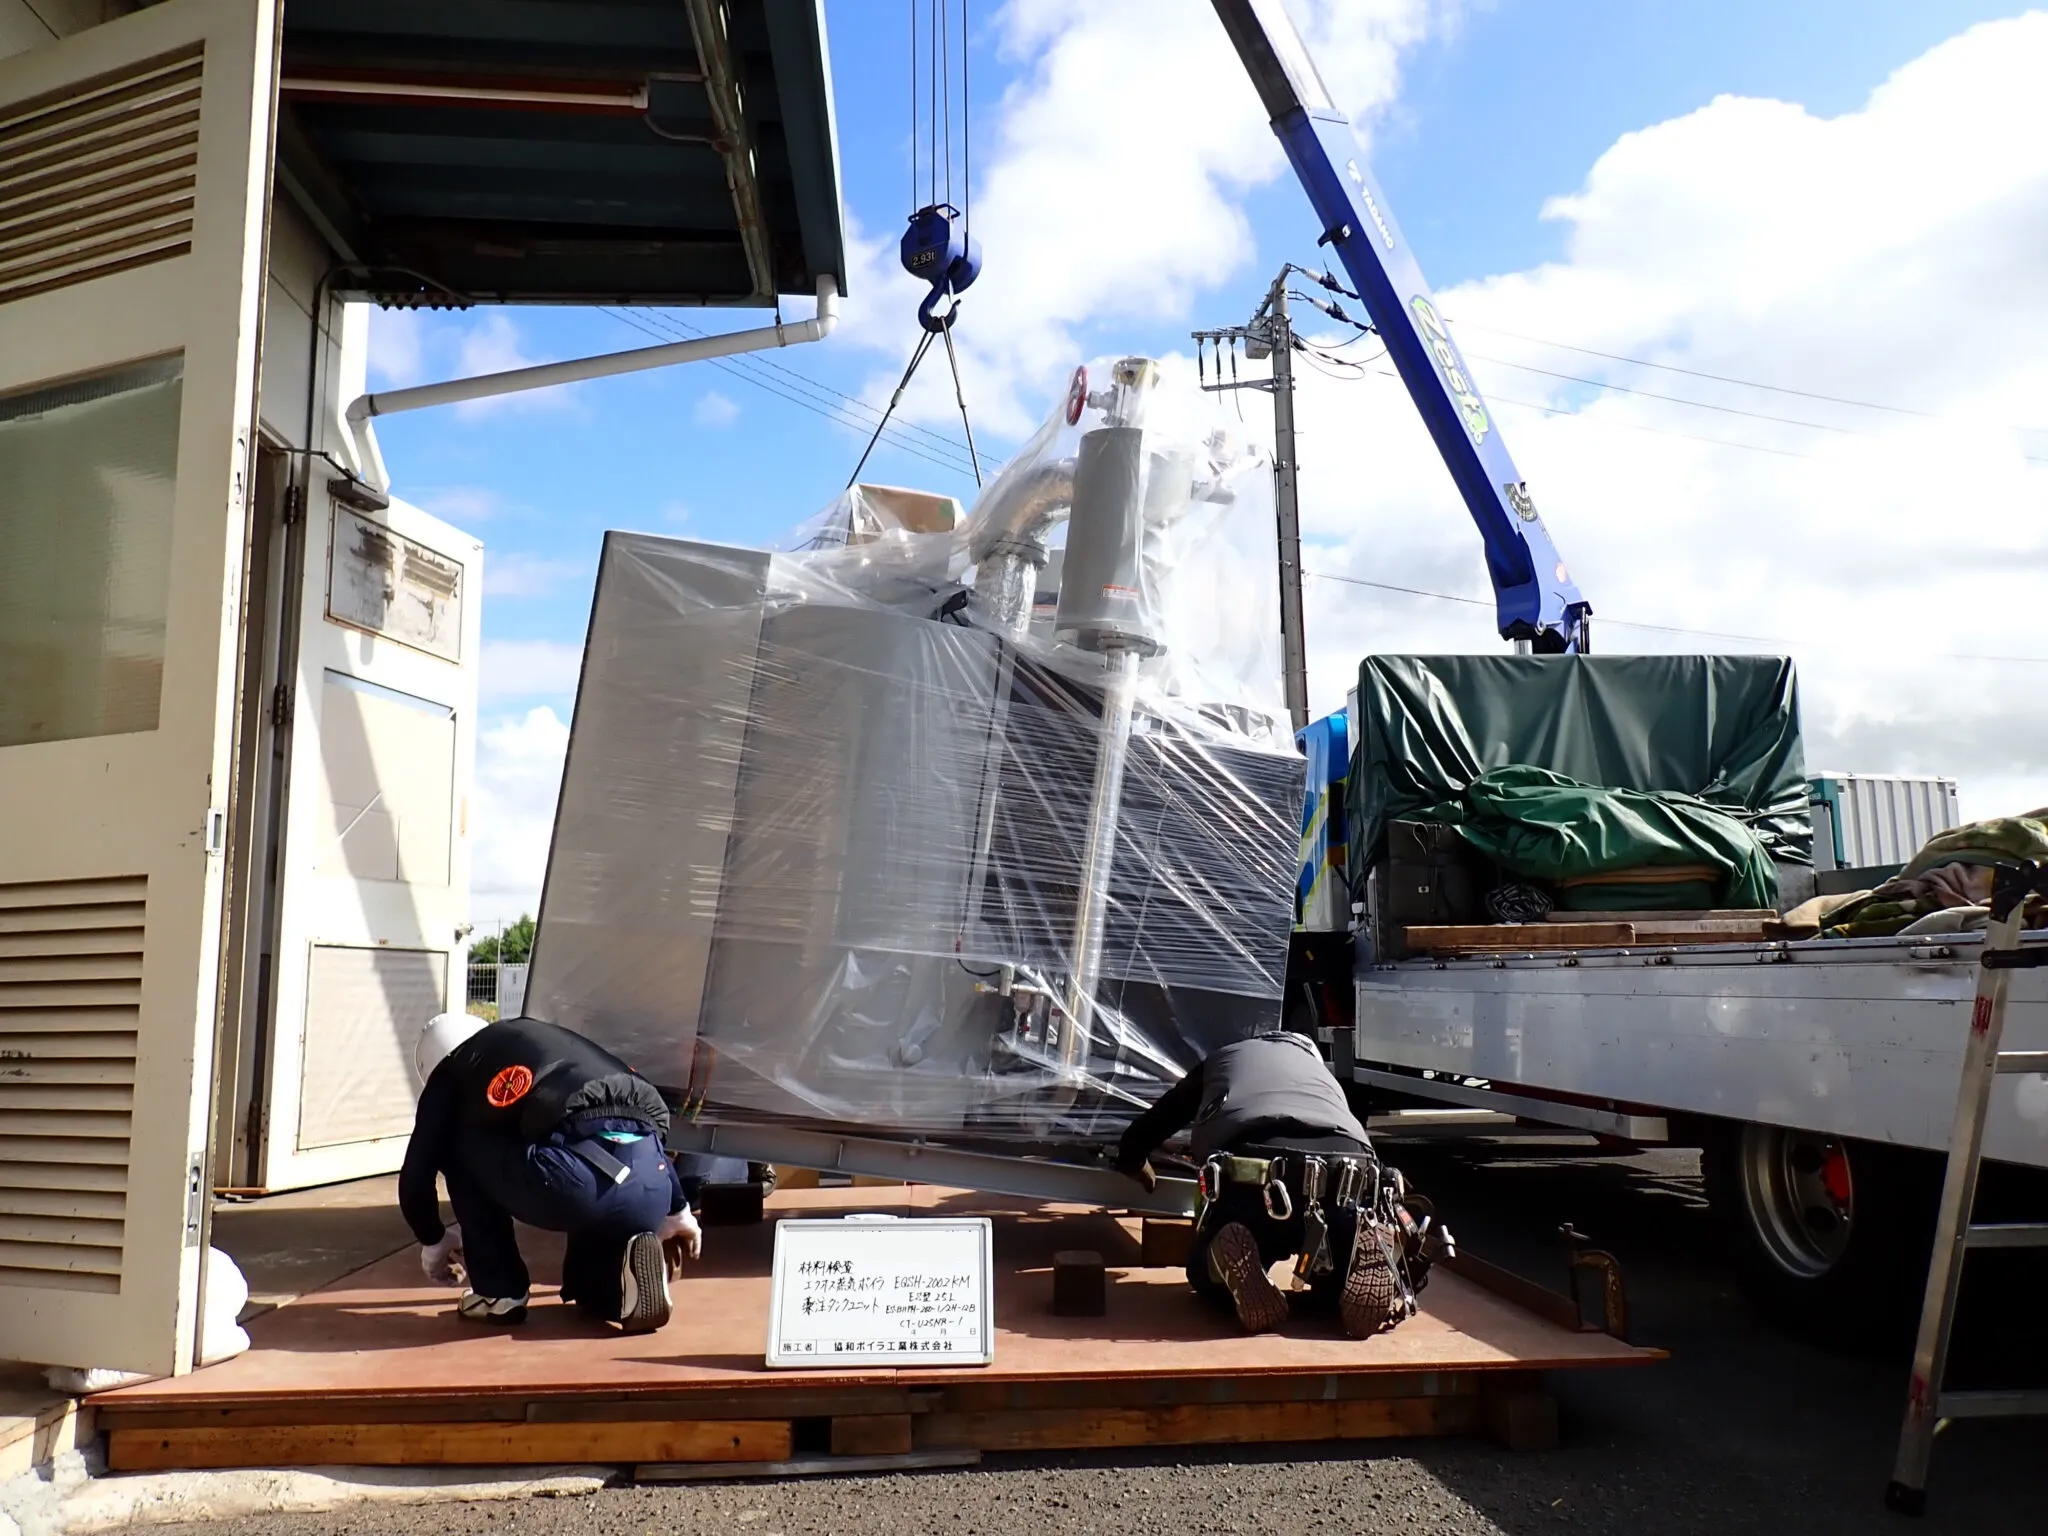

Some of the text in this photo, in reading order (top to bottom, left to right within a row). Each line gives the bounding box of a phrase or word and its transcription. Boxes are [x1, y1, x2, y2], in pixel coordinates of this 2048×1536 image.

[912, 251, 935, 267] 2.93t
[798, 1260, 854, 1277] 材料検査
[833, 1340, 953, 1352] 協和ボイラ工業株式会社
